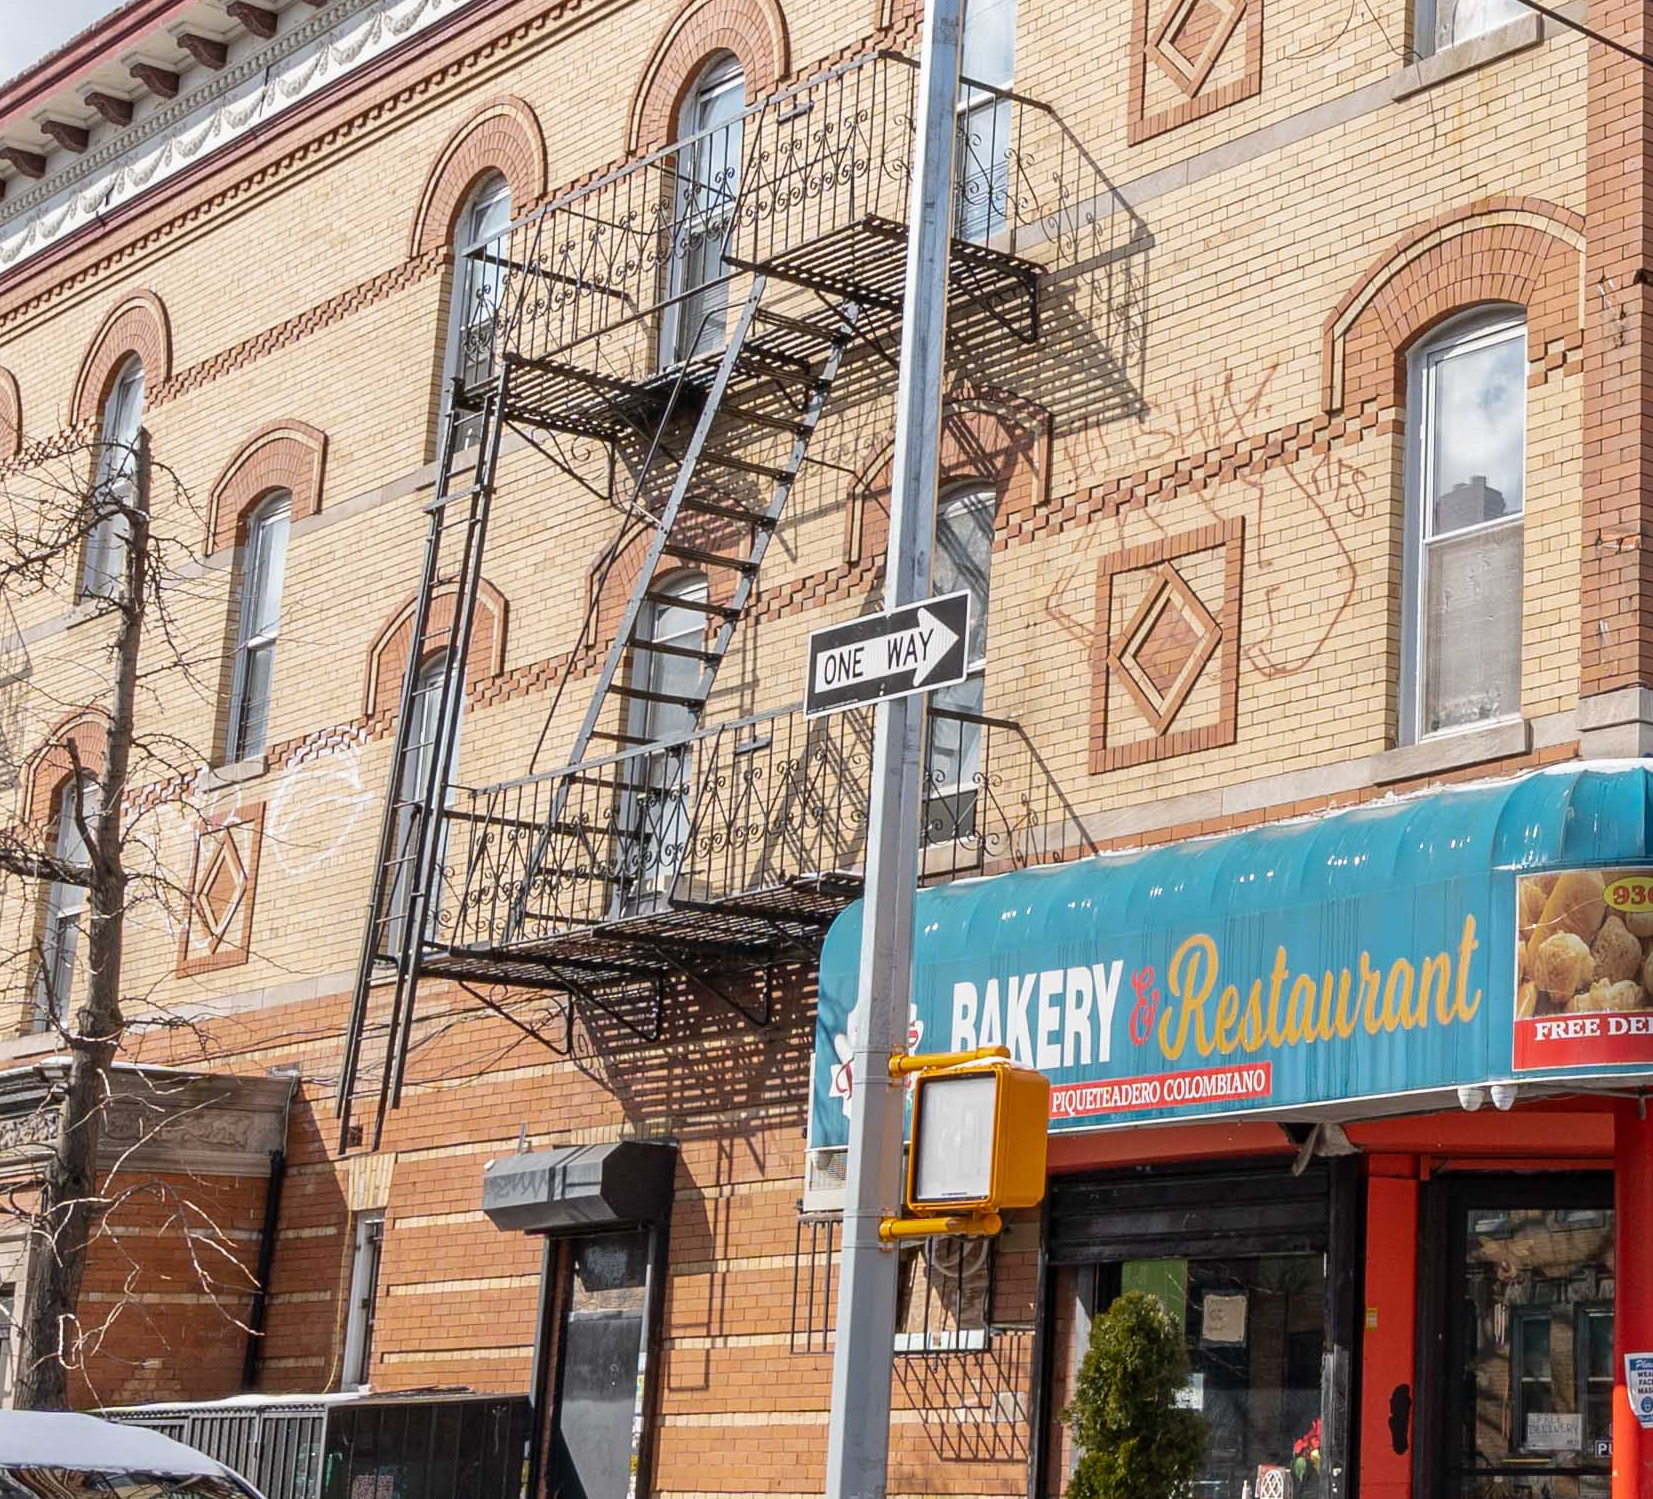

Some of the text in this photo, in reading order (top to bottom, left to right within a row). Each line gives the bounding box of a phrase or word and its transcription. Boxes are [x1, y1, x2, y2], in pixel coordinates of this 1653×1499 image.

[824, 628, 935, 685] ONE WAY
[952, 959, 1124, 1069] BAKERY
[1131, 965, 1160, 1046] &
[1156, 912, 1483, 1061] Restaurant
[1534, 1017, 1601, 1041] FREE
[1051, 1068, 1267, 1115] PIQUETEADERO COLOMBIANO
